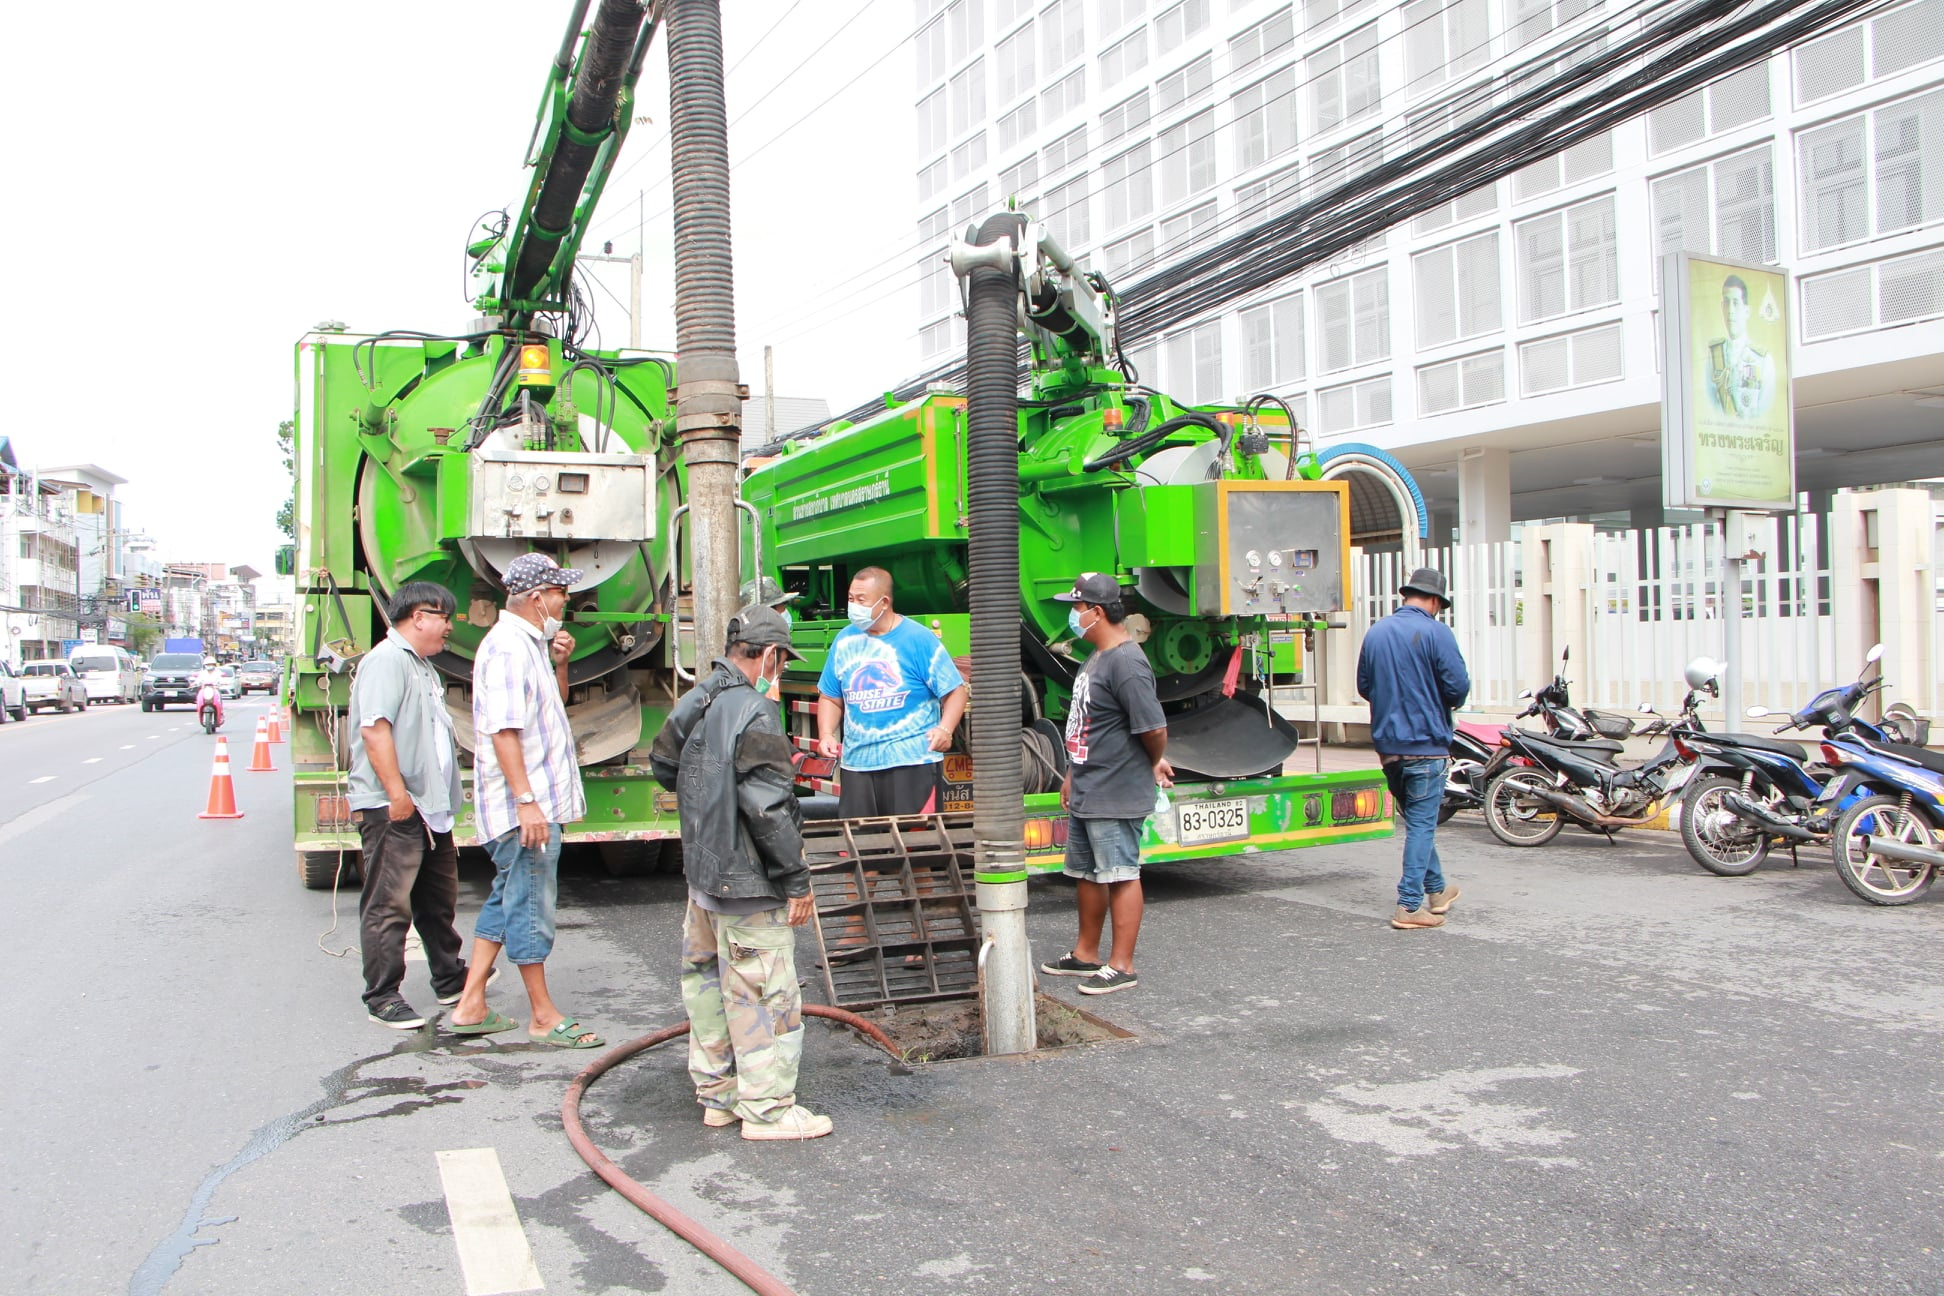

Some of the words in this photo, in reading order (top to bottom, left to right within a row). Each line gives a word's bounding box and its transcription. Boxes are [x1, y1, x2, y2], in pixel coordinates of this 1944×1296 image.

[1698, 431, 1784, 456] ทรงพระเจริญ
[848, 688, 883, 701] BOISE
[862, 696, 902, 710] STATE
[1194, 801, 1232, 810] THAILAND
[1183, 807, 1244, 831] 83-0325
